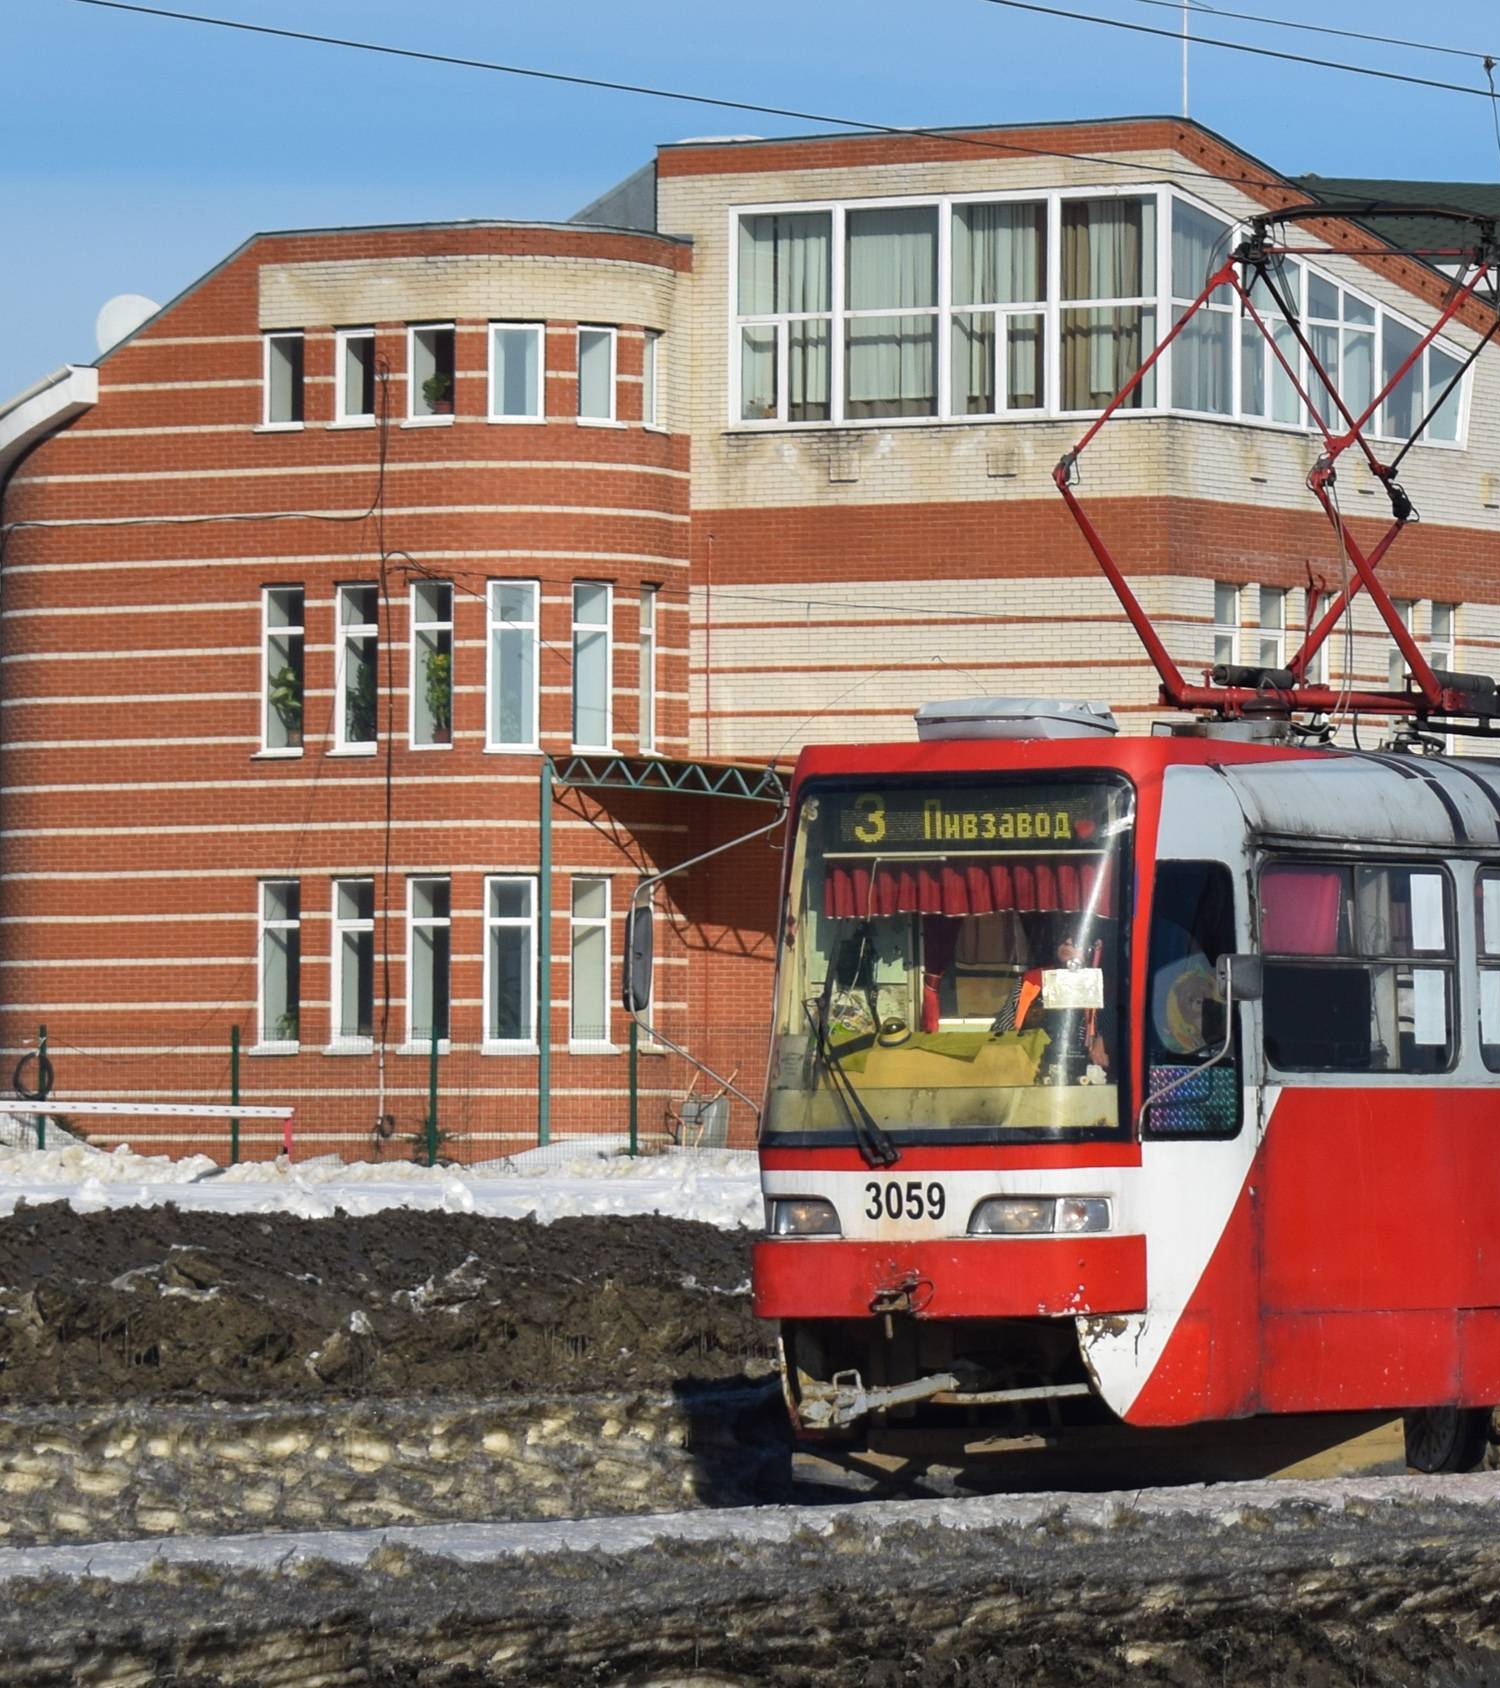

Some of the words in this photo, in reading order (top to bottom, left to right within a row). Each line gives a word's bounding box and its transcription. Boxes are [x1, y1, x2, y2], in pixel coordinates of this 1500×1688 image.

[854, 793, 886, 843] 3
[924, 799, 1072, 839] Пивзавод
[865, 1181, 946, 1220] 3059
